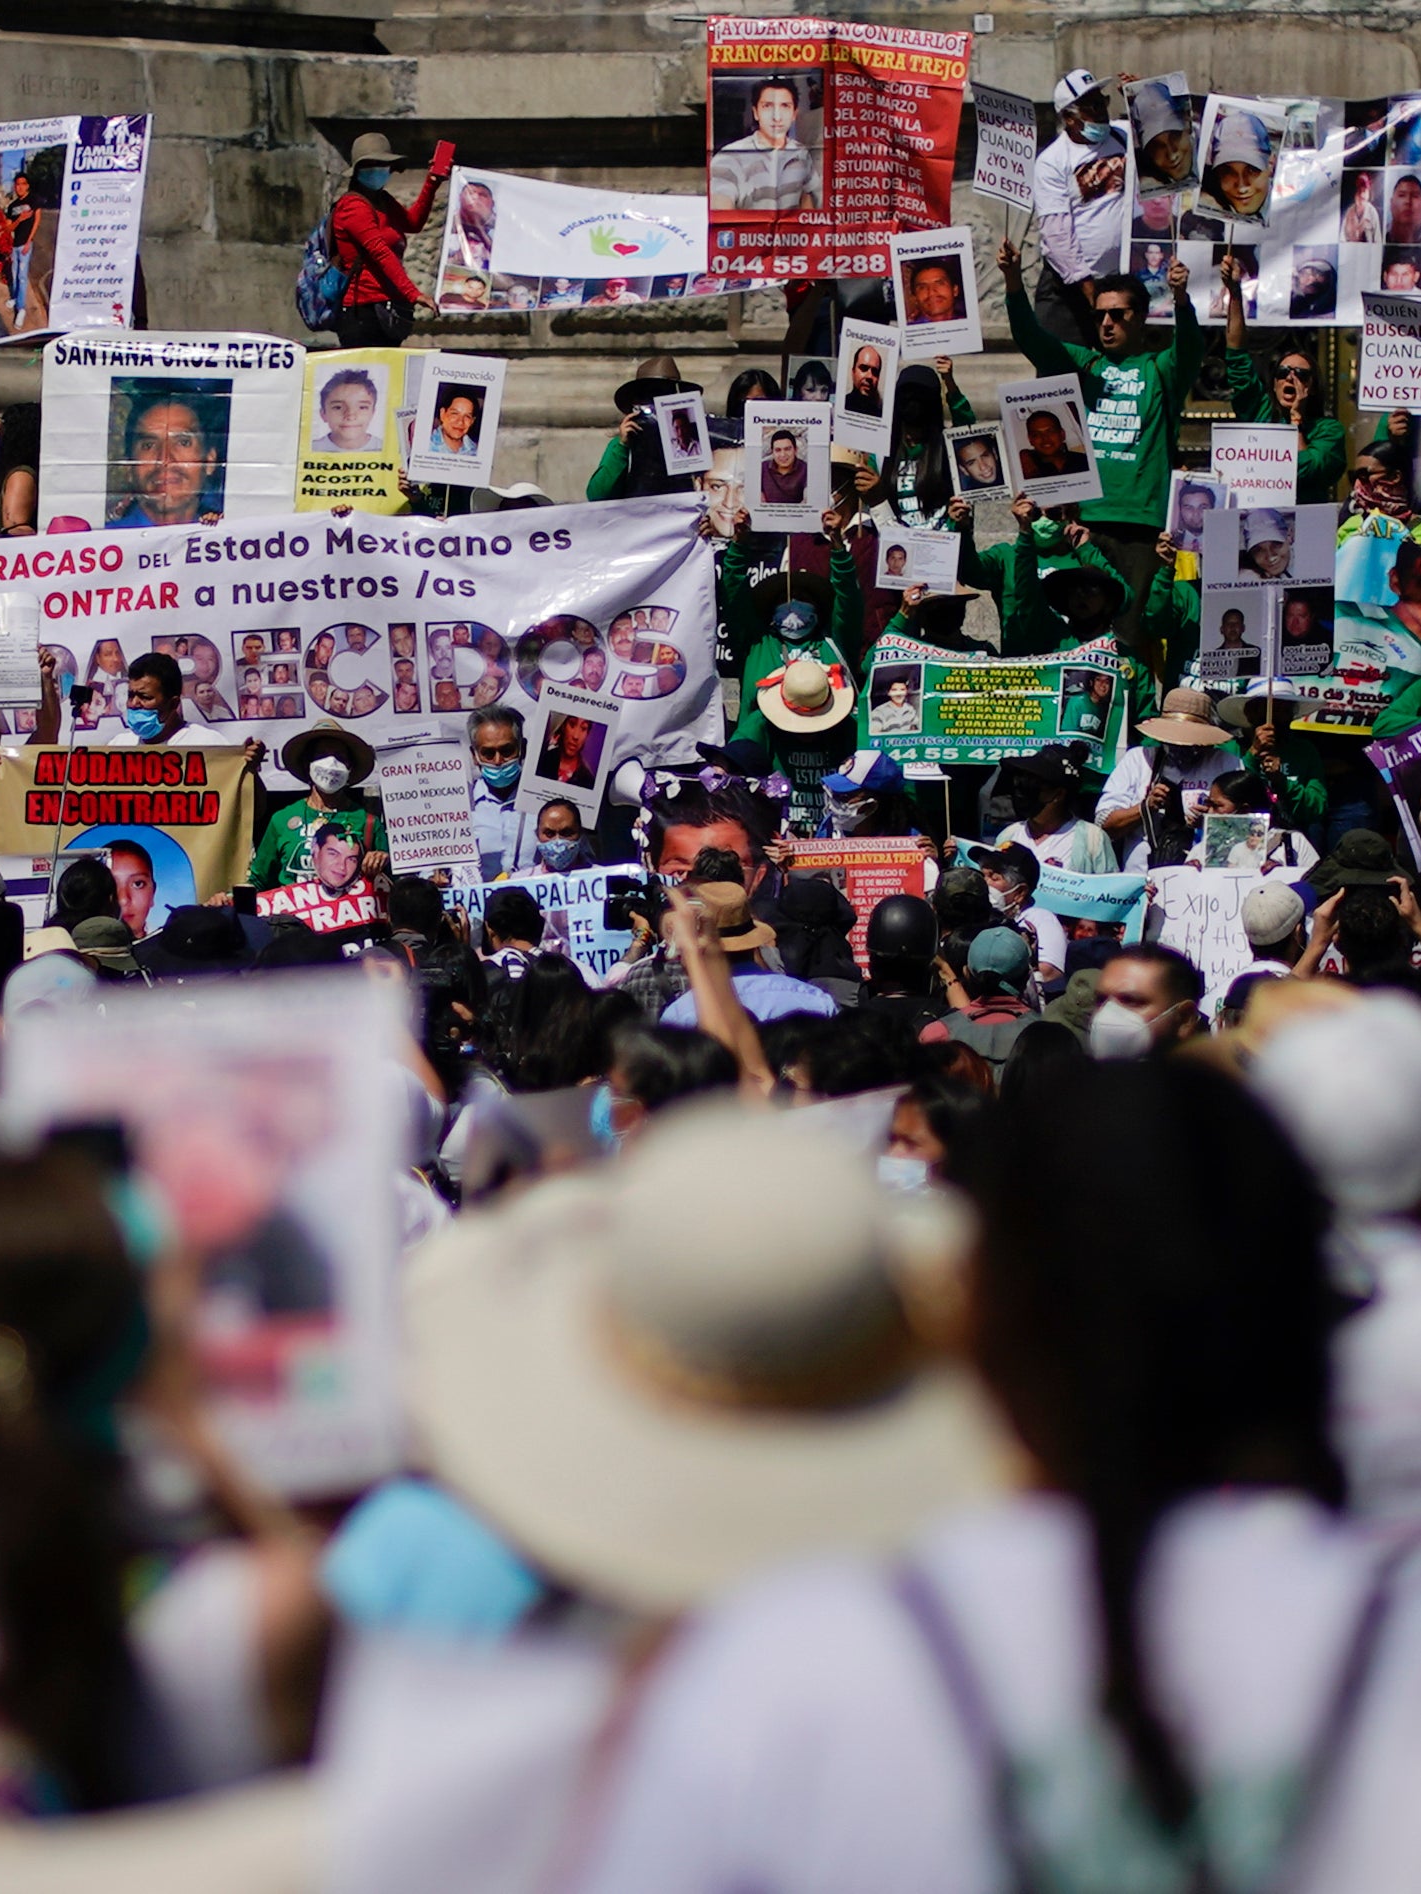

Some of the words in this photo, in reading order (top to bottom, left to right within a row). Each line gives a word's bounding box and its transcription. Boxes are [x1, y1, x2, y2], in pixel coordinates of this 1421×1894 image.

[813, 21, 826, 35] A
[710, 44, 815, 63] FRANCISCO
[820, 46, 906, 72] ALBAVERA
[909, 56, 966, 80] TREJO
[839, 92, 854, 103] 26
[857, 94, 873, 105] DE
[877, 96, 917, 114] MARZO
[834, 108, 857, 120] DEL
[860, 109, 888, 123] 2012
[889, 114, 903, 127] EN
[907, 118, 922, 133] LA
[1020, 106, 1034, 120] TE
[22, 133, 68, 144] Velázquez
[824, 126, 857, 140] LNEA
[861, 127, 866, 138] 1
[871, 128, 893, 144] DEL
[894, 134, 935, 152] METRO
[980, 128, 1032, 160] CUANDO
[75, 145, 142, 158] FAMILIAS
[833, 161, 906, 175] ESTUDIANTE
[908, 168, 923, 181] DE
[987, 152, 1007, 169] ¿YO
[1011, 160, 1025, 177] YA
[882, 180, 906, 192] DEL
[907, 181, 924, 196] IPN
[977, 169, 996, 186] NO
[1000, 177, 1032, 200] ESTÉ?
[85, 194, 131, 204] Coahuila
[829, 196, 844, 208] SE
[846, 196, 928, 214] AGRADECERA
[739, 232, 809, 247] BUSCANDO
[811, 232, 822, 246] A
[824, 230, 891, 247] FRANCISCO
[897, 241, 964, 255] Desaparecido
[711, 255, 765, 274] 044
[773, 255, 809, 274] 55
[818, 253, 886, 273] 4288
[1366, 303, 1418, 318] ¿QUIÉN
[846, 328, 895, 347] Desaparecido
[1366, 323, 1421, 338] BUSCA
[55, 340, 154, 368] SANTANA
[161, 342, 217, 368] CRUZ
[226, 343, 295, 370] REYES
[432, 367, 495, 381] Desaparecido
[1005, 388, 1075, 404] Desaparecido
[1363, 386, 1387, 399] NO
[1393, 387, 1421, 400] EST
[753, 416, 822, 426] Desaparecido
[1248, 435, 1258, 443] EN
[1215, 448, 1292, 462] COAHUILA
[303, 461, 394, 472] BRANDON
[303, 473, 373, 484] ACOSTA
[1230, 478, 1293, 489] SAPARICIÓN
[301, 487, 387, 497] HERRERA
[139, 553, 171, 569] DEL
[185, 531, 309, 563] Estado
[326, 527, 512, 558] Mexicano
[529, 528, 572, 551] es
[43, 581, 179, 618] ONTRAR
[195, 586, 214, 607] a
[232, 574, 398, 604] nuestros
[416, 570, 476, 598] /as
[547, 686, 619, 712] Desaparecido
[1298, 687, 1319, 698] 18
[1323, 688, 1344, 700] de
[1349, 690, 1393, 704] junio
[34, 746, 183, 786] AYÚDANOS
[184, 751, 207, 786] A
[382, 764, 412, 777] GRAN
[416, 760, 462, 773] FRACASO
[386, 791, 418, 802] ESTADO
[420, 786, 465, 798] MEXICANO
[25, 791, 220, 825] ENCONTRARLA
[389, 817, 405, 829] NO
[407, 811, 469, 826] ENCONTRAR
[392, 835, 399, 844] A
[401, 831, 450, 842] NUESTROS
[460, 828, 471, 837] AS
[393, 844, 474, 862] DESAPARECIDOS
[1042, 871, 1067, 885] visto
[257, 880, 365, 917] DANOS
[538, 876, 606, 909] PALAC
